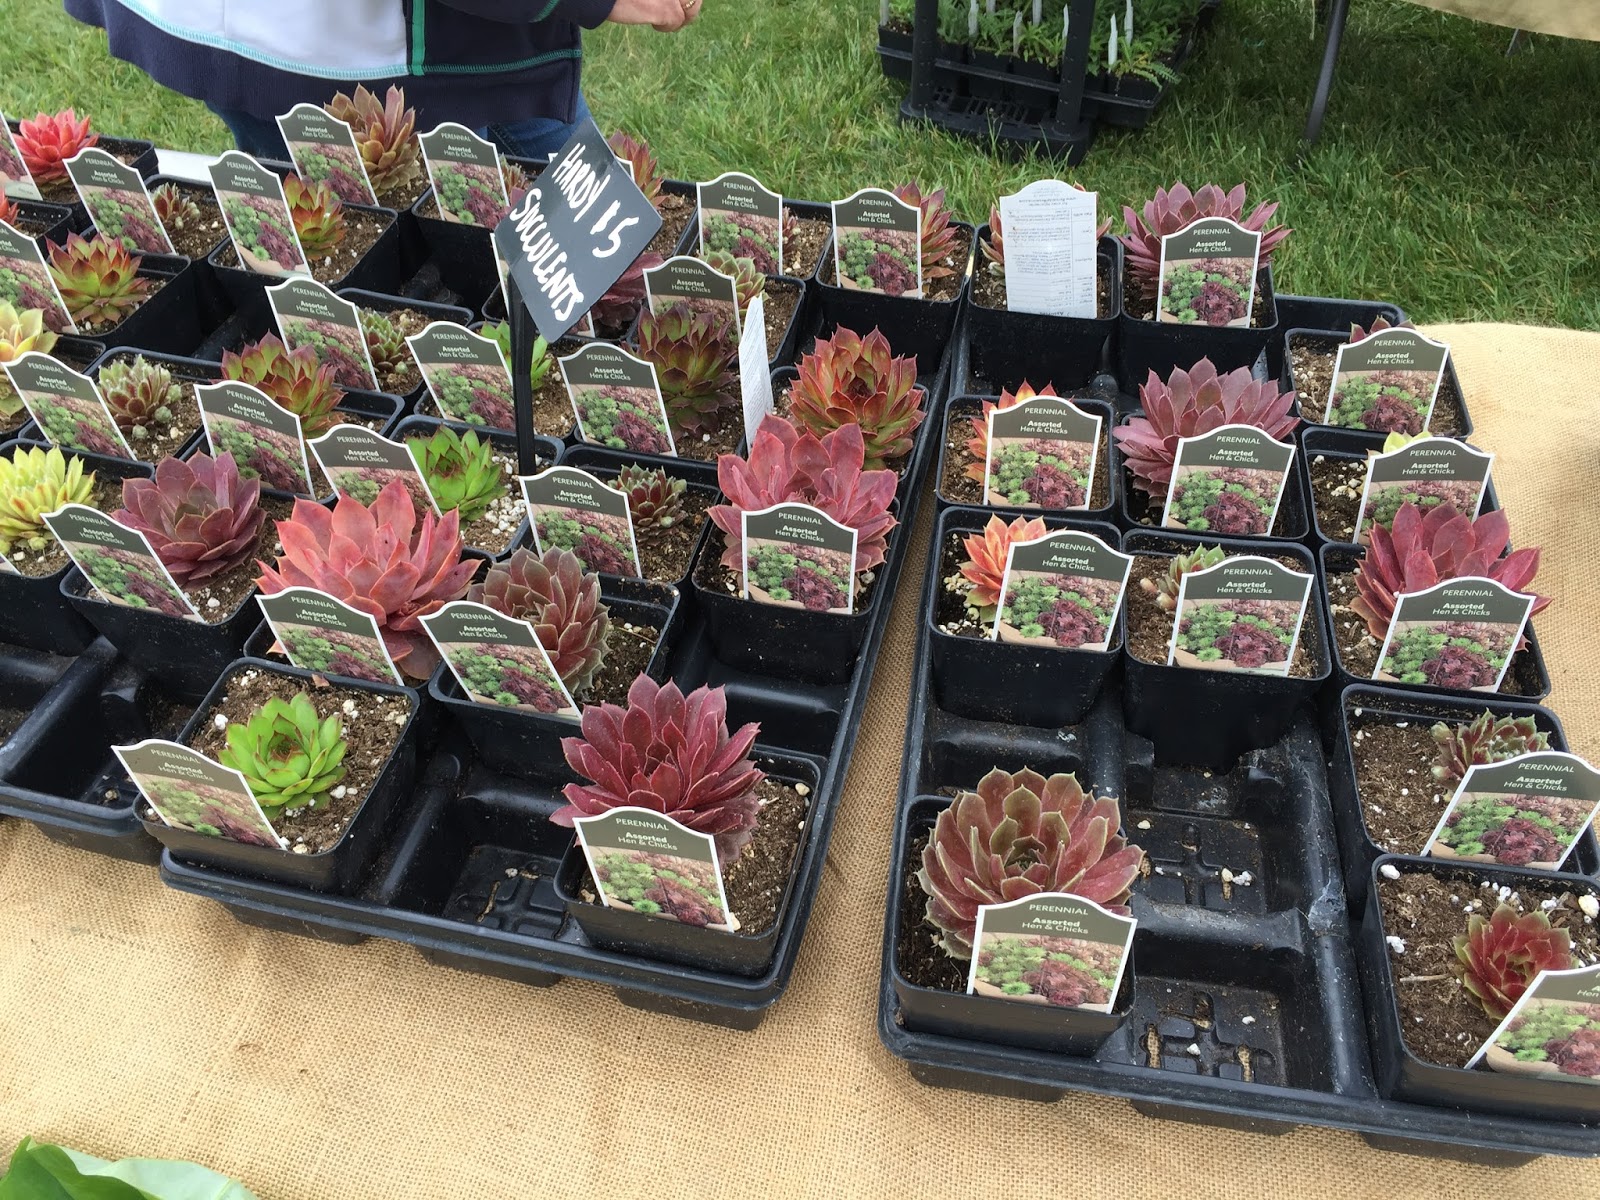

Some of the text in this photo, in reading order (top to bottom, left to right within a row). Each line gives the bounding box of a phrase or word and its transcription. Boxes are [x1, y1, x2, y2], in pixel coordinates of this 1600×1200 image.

[297, 114, 327, 122] PERENNIAL
[441, 133, 471, 142] PERENNIAL
[447, 144, 471, 153] Assorted
[461, 150, 478, 159] Chicks
[84, 157, 115, 167] PERENNIAL
[226, 161, 256, 172] PERENNIAL
[94, 170, 118, 179] Assorted
[234, 174, 257, 183] Assorted
[248, 182, 264, 191] Chicks
[552, 143, 610, 222] HARDY
[723, 182, 756, 193] PERENNIAL
[727, 194, 753, 204] Assorted
[858, 198, 893, 207] PERENNIAL
[740, 200, 759, 210] Chicks
[862, 210, 890, 219] Assorted
[876, 217, 896, 225] Chicks
[1193, 228, 1231, 236] PERENNIAL
[1195, 240, 1227, 248] Assorted
[1210, 245, 1232, 253] Chicks
[509, 188, 584, 321] SUCCULENTS
[670, 266, 706, 276] PERENNIAL
[676, 279, 705, 287] Assorted
[292, 287, 328, 299] PERENNIAL
[691, 285, 711, 294] Chicks
[300, 300, 328, 311] Assorted
[315, 308, 335, 318] Chicks
[432, 333, 469, 341] PERENNIAL
[442, 345, 471, 353] Assorted
[457, 351, 479, 359] Chicks
[586, 354, 624, 362] PERENNIAL
[27, 362, 64, 374] PERENNIAL
[594, 366, 623, 375] Assorted
[39, 375, 67, 385] Assorted
[609, 373, 631, 381] Chicks
[55, 383, 76, 393] Chicks
[226, 389, 267, 407] PERENNIAL
[233, 402, 266, 417] Assorted
[1024, 407, 1068, 416] PERENNIAL
[227, 406, 242, 416] Hen
[250, 413, 273, 425] Chicks
[1027, 420, 1062, 428] Assorted
[1044, 426, 1068, 434] Chicks
[336, 435, 377, 445] PERENNIAL
[1216, 435, 1261, 445] PERENNIAL
[348, 449, 380, 457] Assorted
[1217, 448, 1254, 456] Assorted
[1409, 449, 1457, 457] PERENNIAL
[366, 455, 389, 463] Chicks
[1233, 454, 1259, 463] Chicks
[552, 476, 594, 489] PERENNIAL
[559, 489, 593, 500] Assorted
[554, 494, 570, 502] Hen
[577, 497, 601, 507] Chicks
[69, 513, 110, 527] PERENNIAL
[778, 512, 823, 525] PERENNIAL
[82, 527, 114, 538] Assorted
[782, 525, 818, 536] Assorted
[101, 534, 125, 545] Chicks
[799, 532, 825, 543] Chicks
[1049, 541, 1097, 553] PERENNIAL
[1051, 554, 1089, 565] Assorted
[1067, 562, 1095, 572] Chicks
[1223, 568, 1274, 576] PERENNIAL
[1442, 589, 1494, 597] PERENNIAL
[290, 596, 337, 609] PERENNIAL
[1442, 602, 1485, 610] Assorted
[301, 609, 338, 620] Assorted
[450, 612, 495, 621] PERENNIAL
[295, 613, 312, 621] Hen
[320, 616, 347, 627] Chicks
[463, 625, 498, 633] Assorted
[482, 631, 508, 639] Chicks
[150, 748, 201, 764] PERENNIAL
[164, 762, 203, 774] Assorted
[1517, 762, 1575, 773] PERENNIAL
[158, 765, 177, 774] Hen
[186, 770, 214, 782] Chicks
[1516, 775, 1563, 785] Assorted
[1536, 782, 1568, 791] Chicks
[615, 817, 670, 831] PERENNIAL
[625, 831, 668, 843] Assorted
[618, 836, 637, 845] Hen
[647, 840, 678, 851] Chicks
[1029, 904, 1089, 916] PERENNIAL
[1032, 916, 1081, 927] Assorted
[1055, 924, 1089, 934] Chicks
[1577, 989, 1599, 997] Hen
